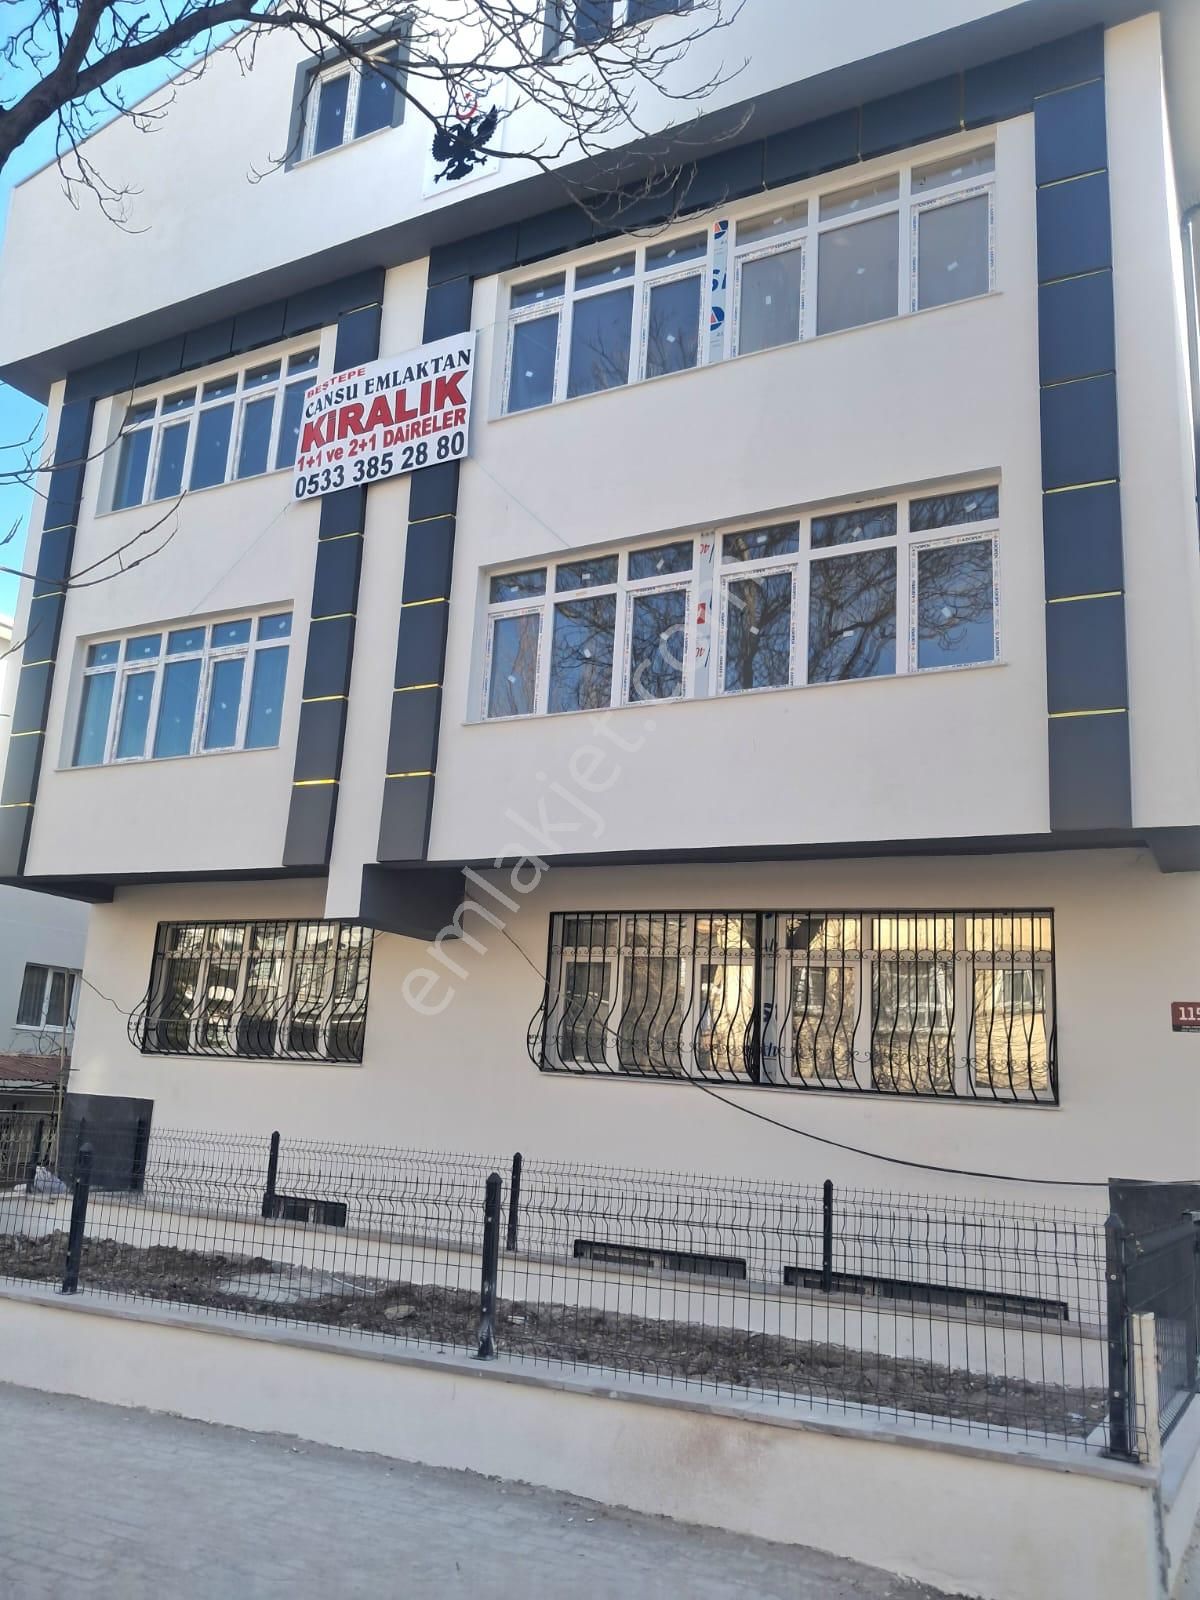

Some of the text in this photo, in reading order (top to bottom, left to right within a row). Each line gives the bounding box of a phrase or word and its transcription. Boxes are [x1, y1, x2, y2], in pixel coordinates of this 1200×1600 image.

[305, 349, 472, 419] CANSU EMLAKTAN
[295, 431, 465, 499] 0533 385 28 80
[297, 446, 323, 472] 1+1
[326, 446, 344, 464] ve
[348, 434, 377, 458] 2+1
